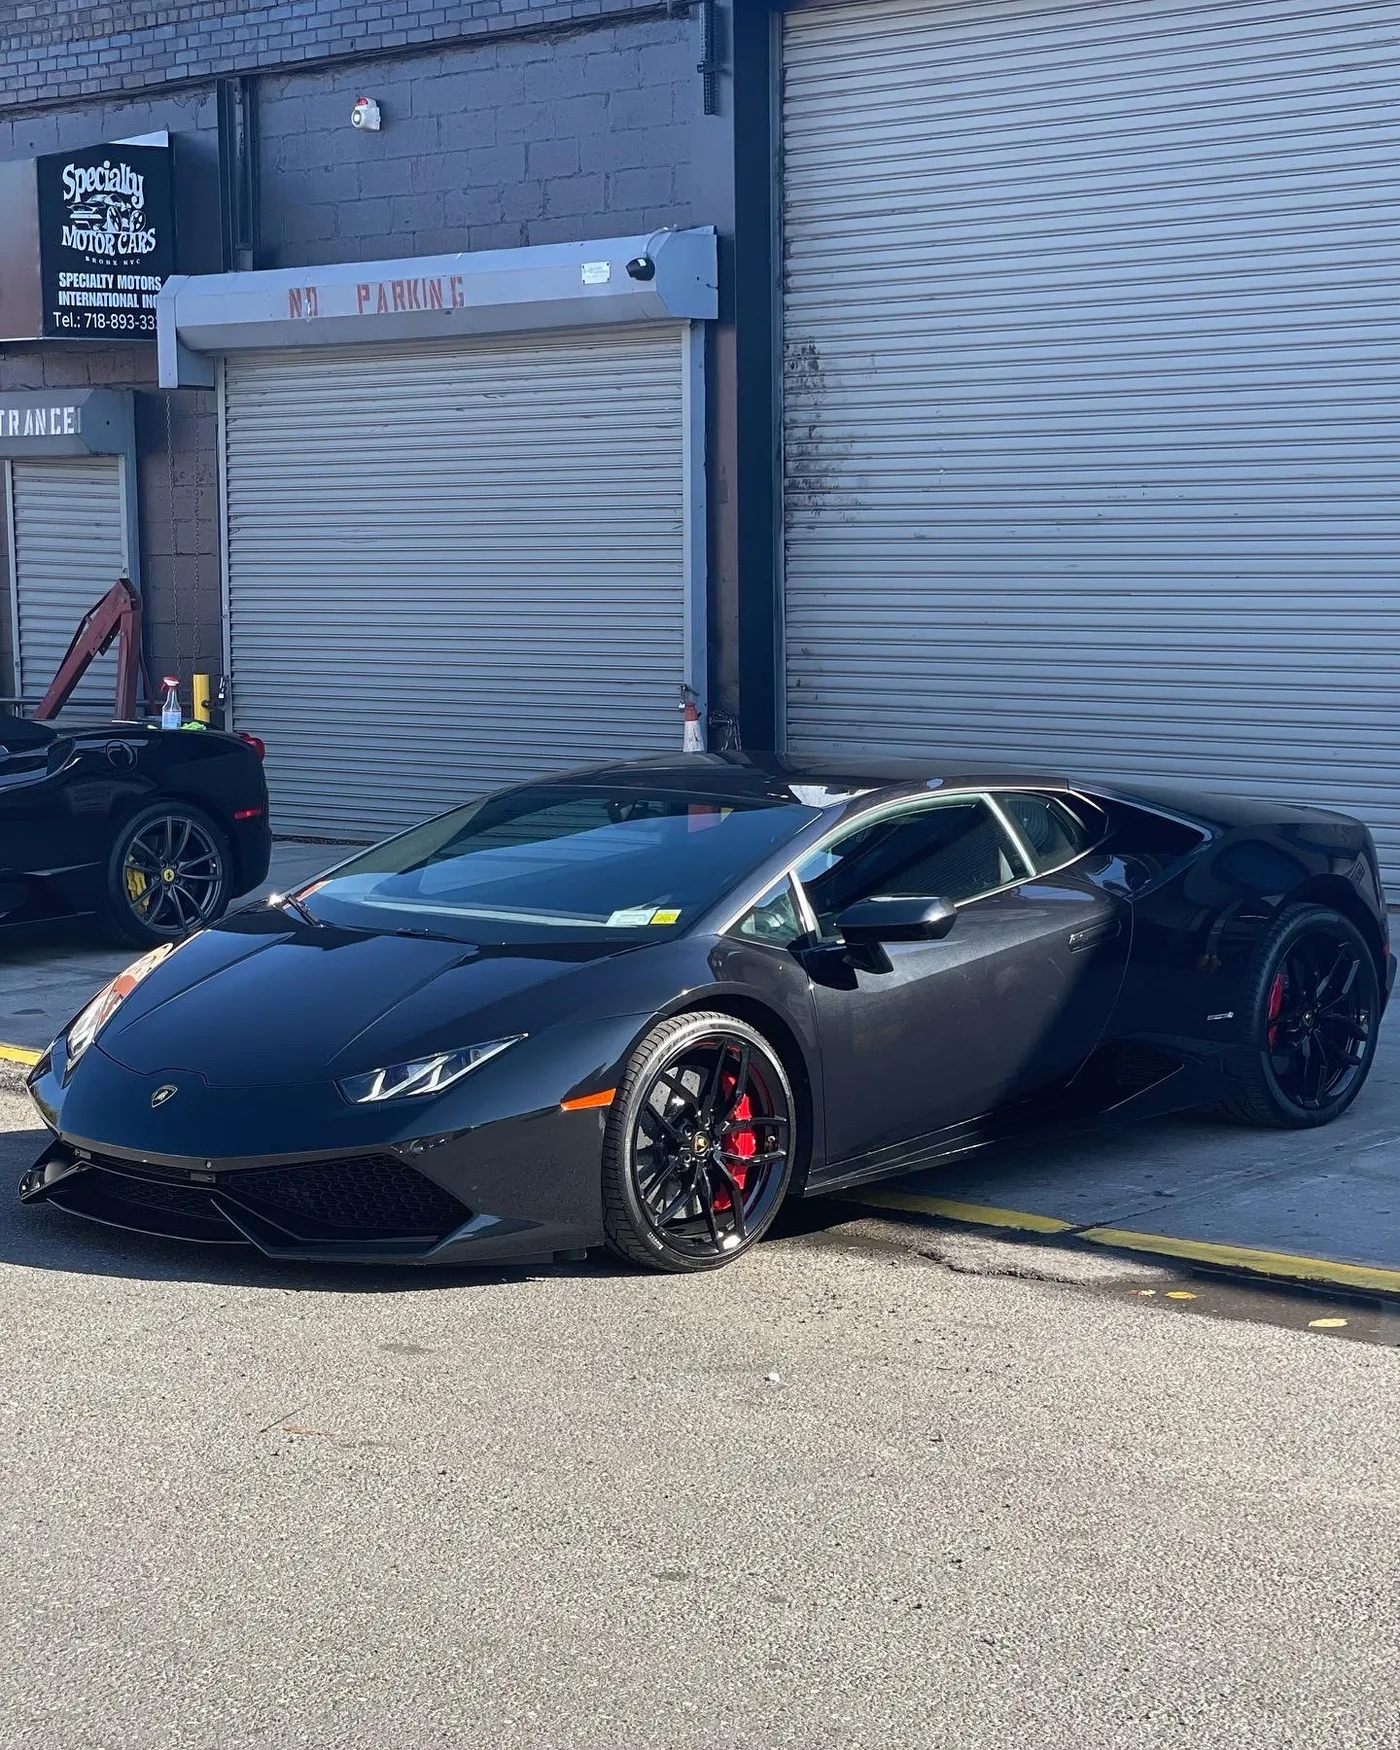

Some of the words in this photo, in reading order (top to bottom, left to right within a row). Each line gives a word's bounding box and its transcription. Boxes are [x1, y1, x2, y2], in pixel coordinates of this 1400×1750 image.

[62, 160, 144, 209] Specialty
[61, 225, 116, 256] MOTOR
[117, 227, 156, 254] CARS
[85, 256, 117, 266] BRONX
[123, 258, 140, 266] NYC
[59, 272, 114, 289] SPECIALTY
[117, 274, 162, 291] MOTORS
[58, 291, 140, 308] INTERNATIONAL
[357, 276, 465, 313] PARKING
[53, 312, 81, 328] Tel.:
[84, 313, 158, 330] 718-893-33
